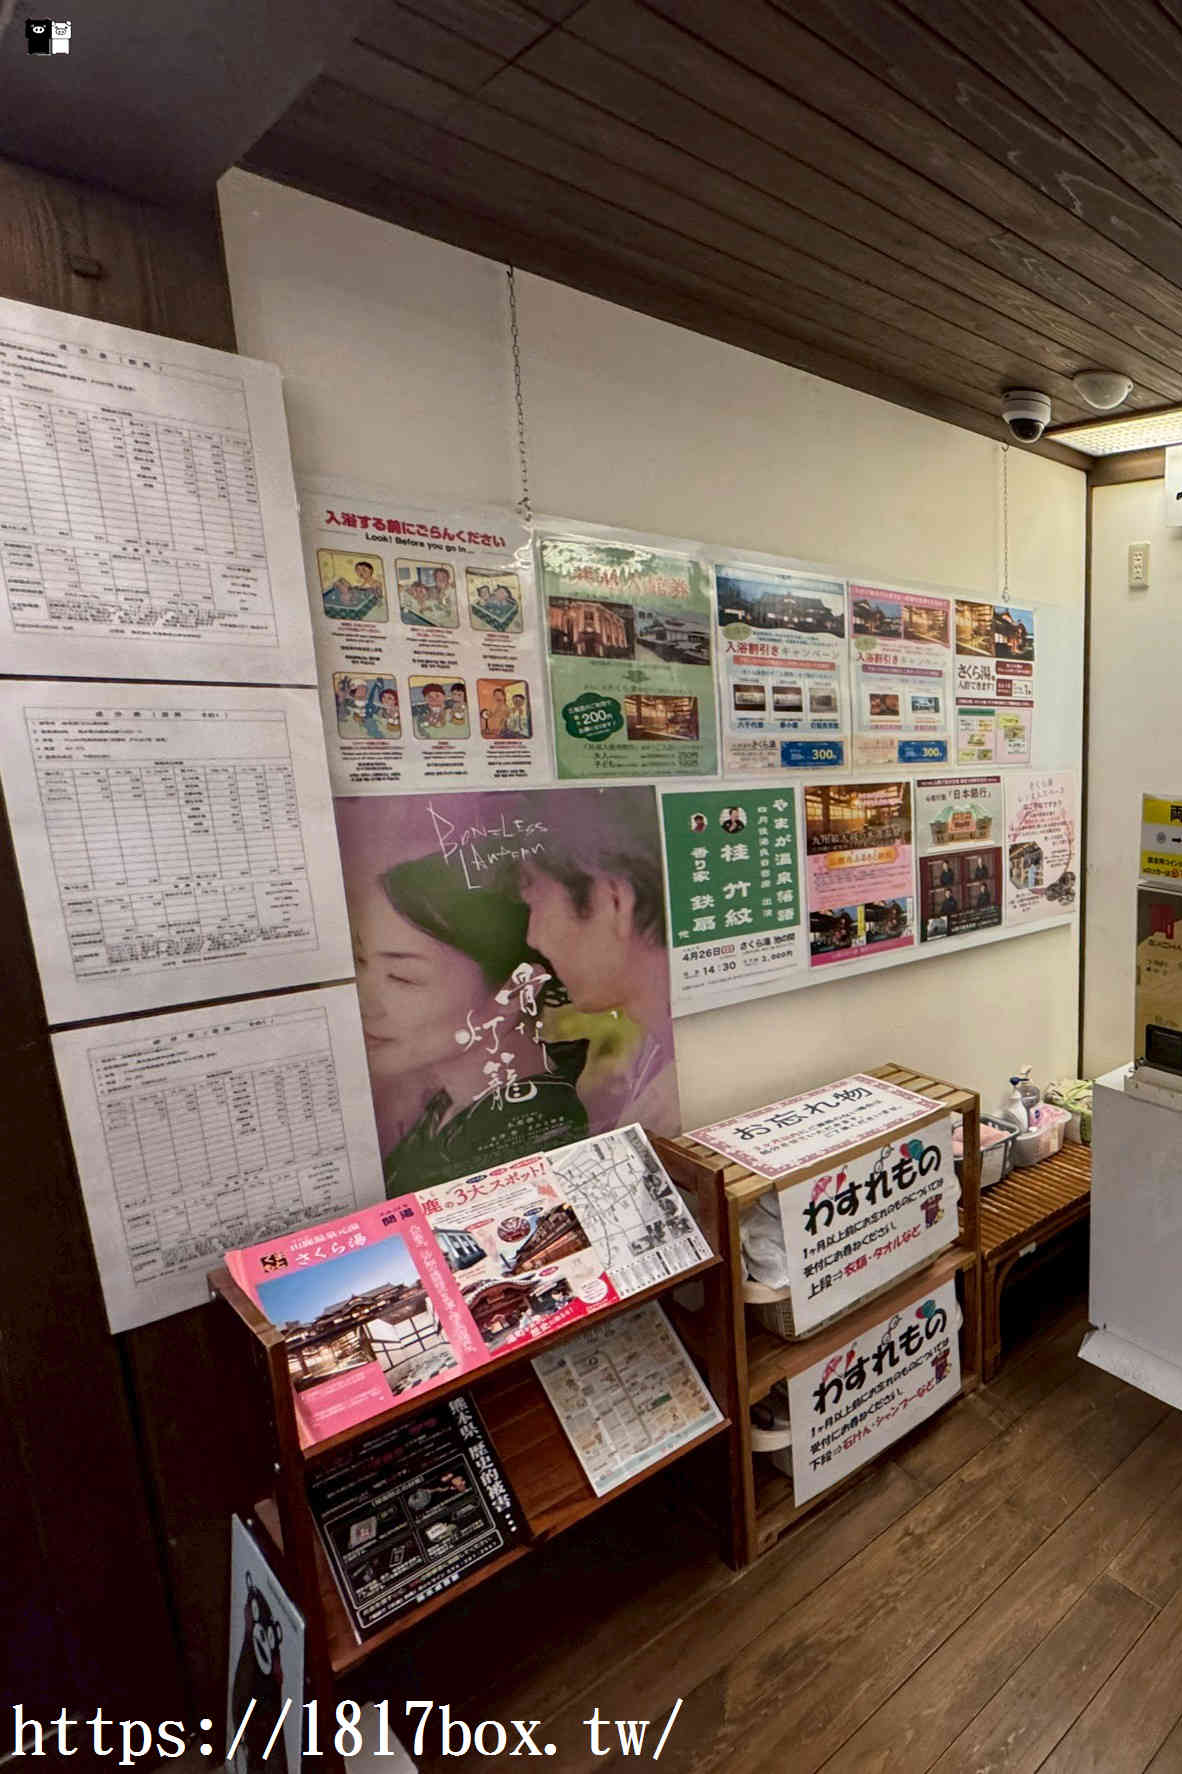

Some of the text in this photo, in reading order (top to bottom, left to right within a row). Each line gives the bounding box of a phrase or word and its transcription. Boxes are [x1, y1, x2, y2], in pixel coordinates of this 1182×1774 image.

[366, 533, 393, 544] Look!
[395, 537, 425, 549] Before
[427, 542, 444, 552] you
[446, 545, 458, 553] go
[733, 1087, 873, 1141] お忘れ物
[803, 1145, 941, 1236] わすれもの
[296, 1235, 368, 1266] さくら湯
[813, 1308, 947, 1415] わすれもの
